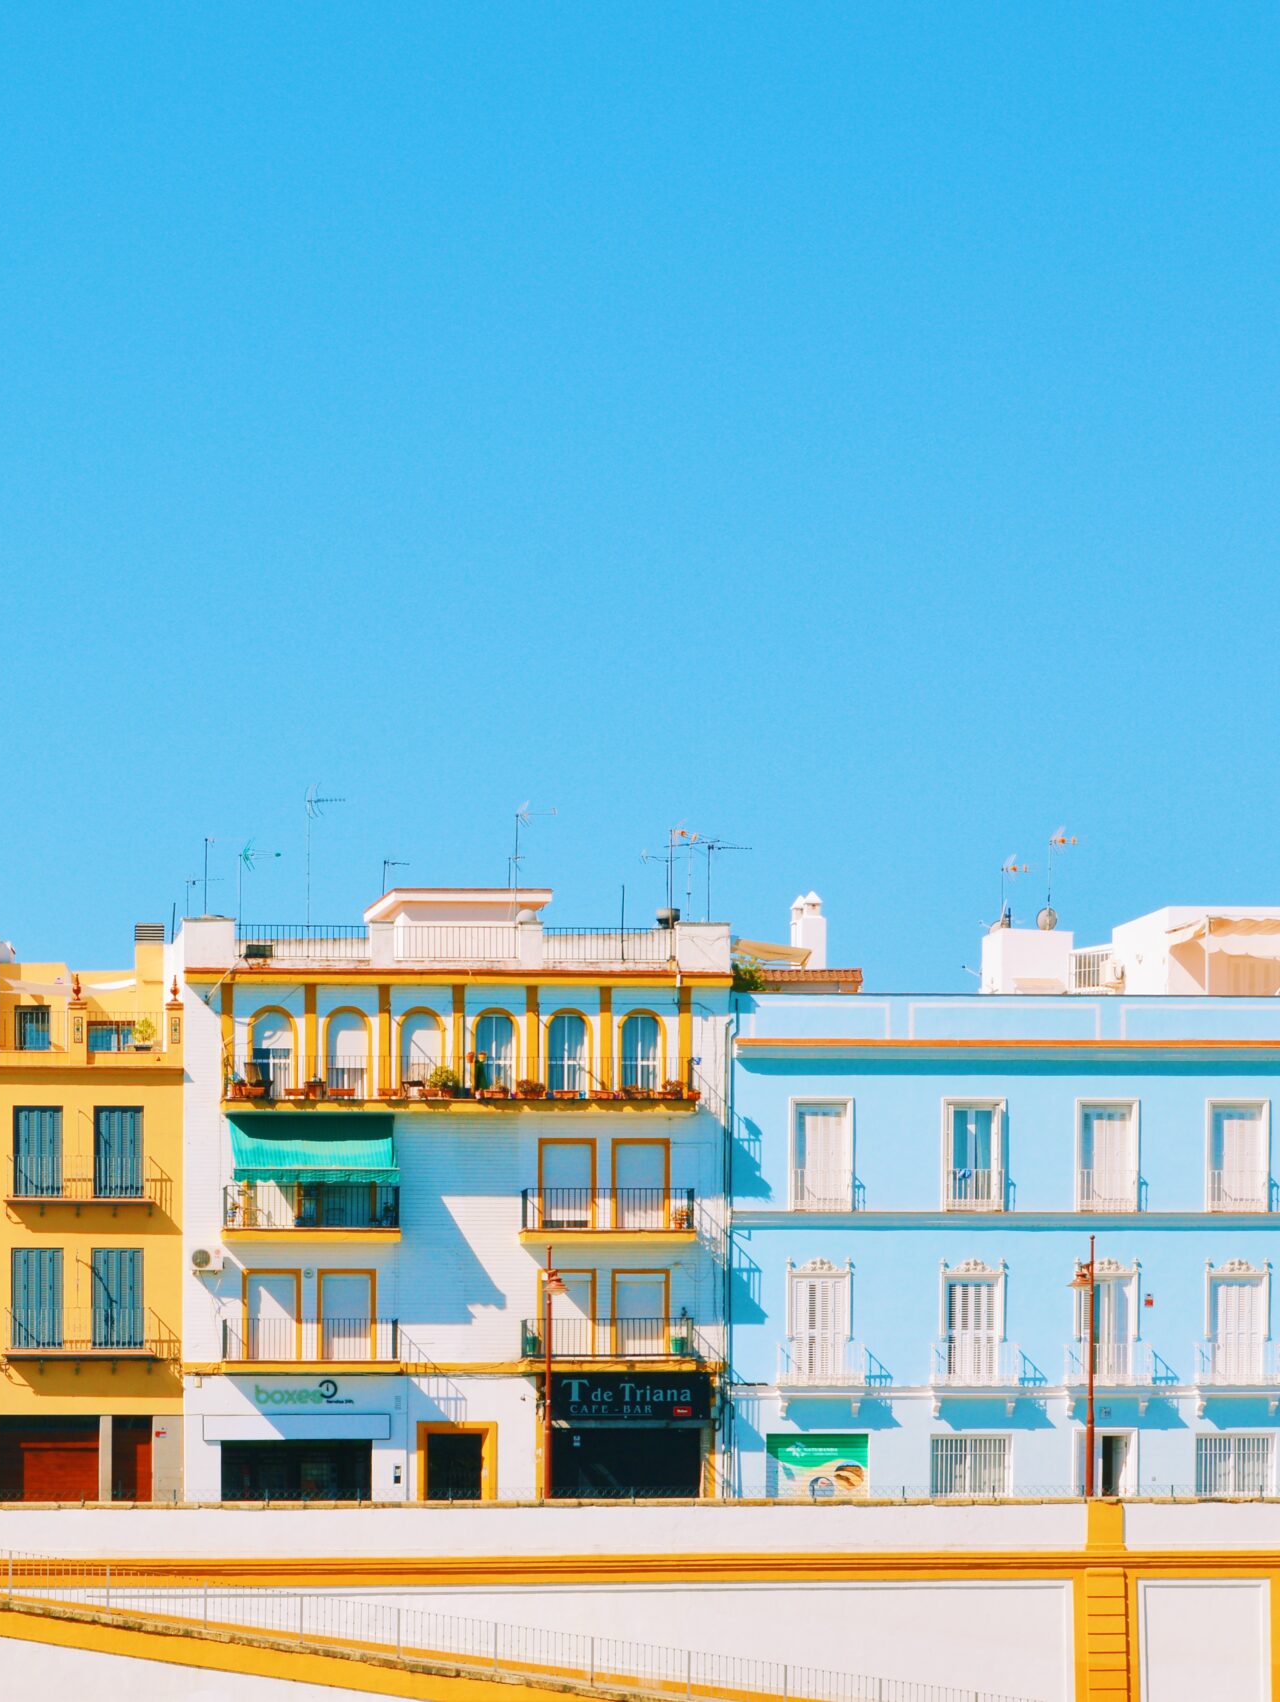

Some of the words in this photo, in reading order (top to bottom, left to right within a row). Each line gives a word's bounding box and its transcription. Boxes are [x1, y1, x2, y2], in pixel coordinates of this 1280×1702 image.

[255, 1384, 322, 1404] boxes
[561, 1379, 590, 1402] T
[591, 1387, 613, 1402] de
[619, 1383, 692, 1402] Triana
